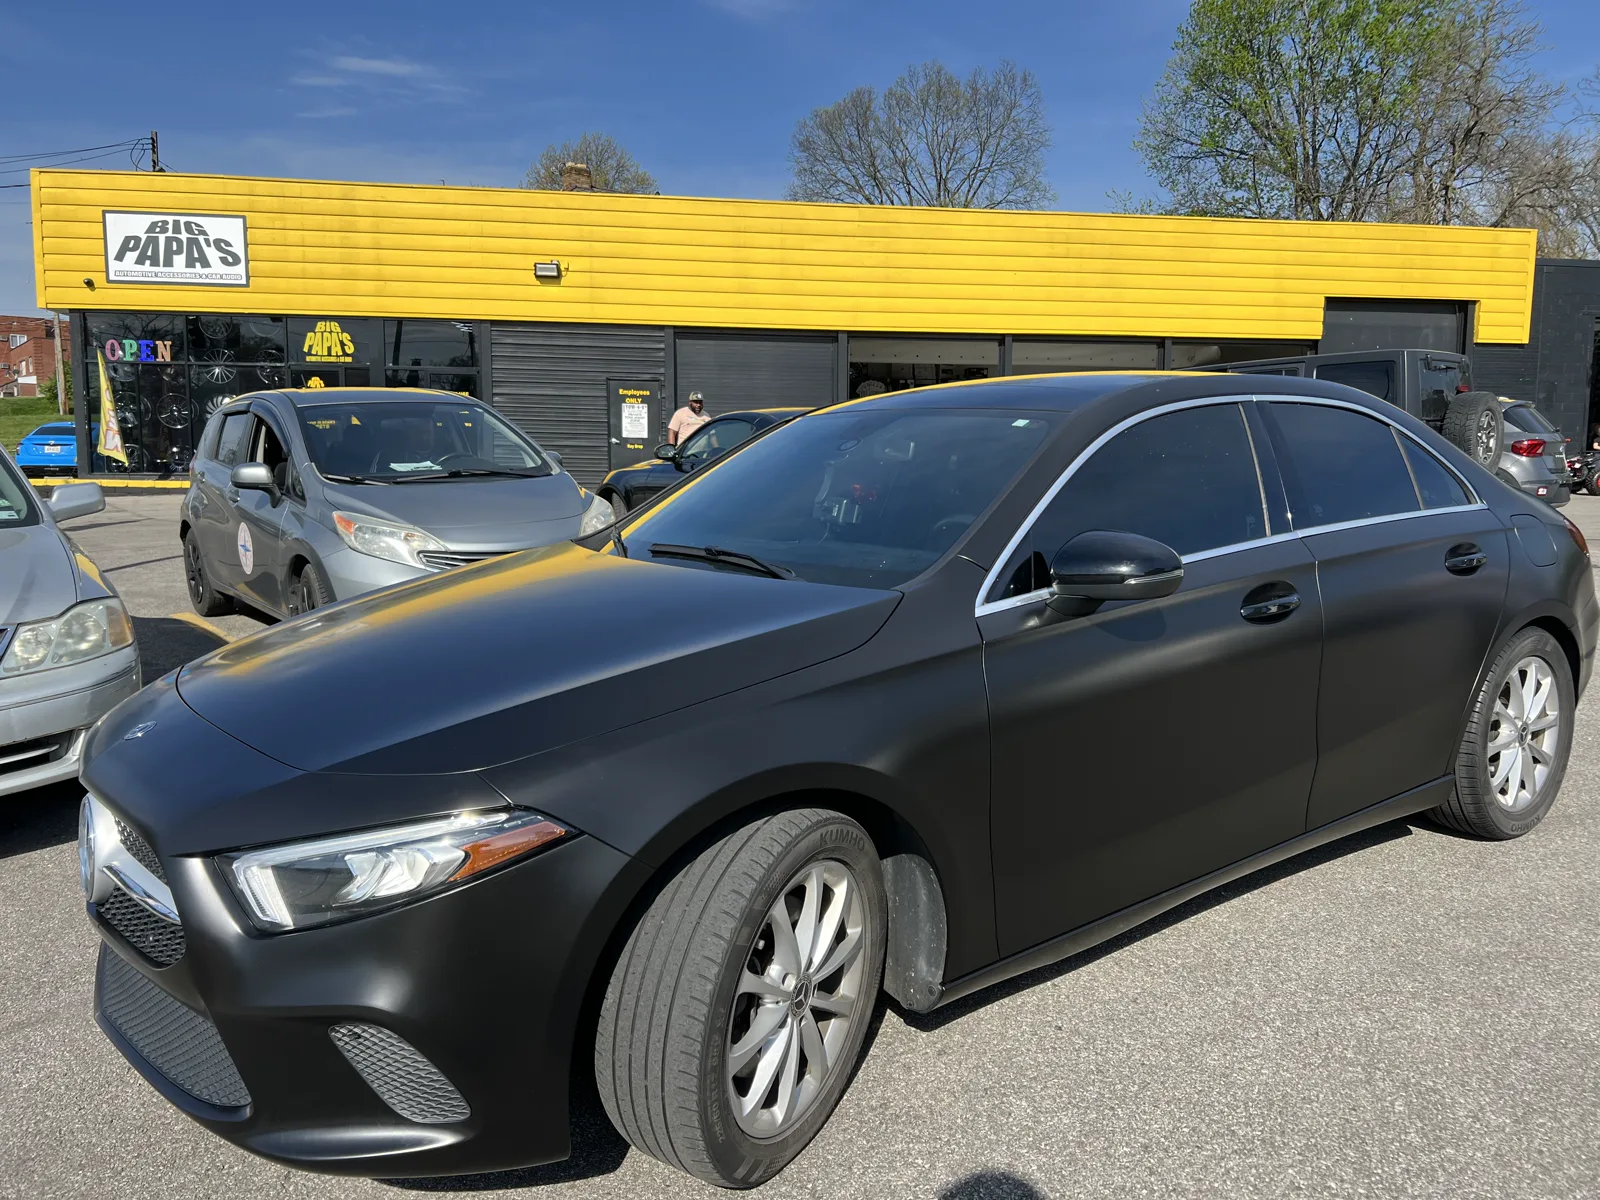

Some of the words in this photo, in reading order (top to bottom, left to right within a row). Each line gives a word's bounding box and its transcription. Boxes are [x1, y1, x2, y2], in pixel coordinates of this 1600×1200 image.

[144, 219, 210, 237] BIG
[113, 235, 242, 269] PAPA'S
[115, 270, 156, 278] AUTOMOTIVE
[157, 271, 200, 279] ACCESSORIES
[315, 320, 341, 333] BIG
[105, 339, 172, 362] OPEN
[303, 332, 354, 356] PAPA'S
[1510, 815, 1540, 833] KUMHO
[820, 828, 865, 852] KUMHO
